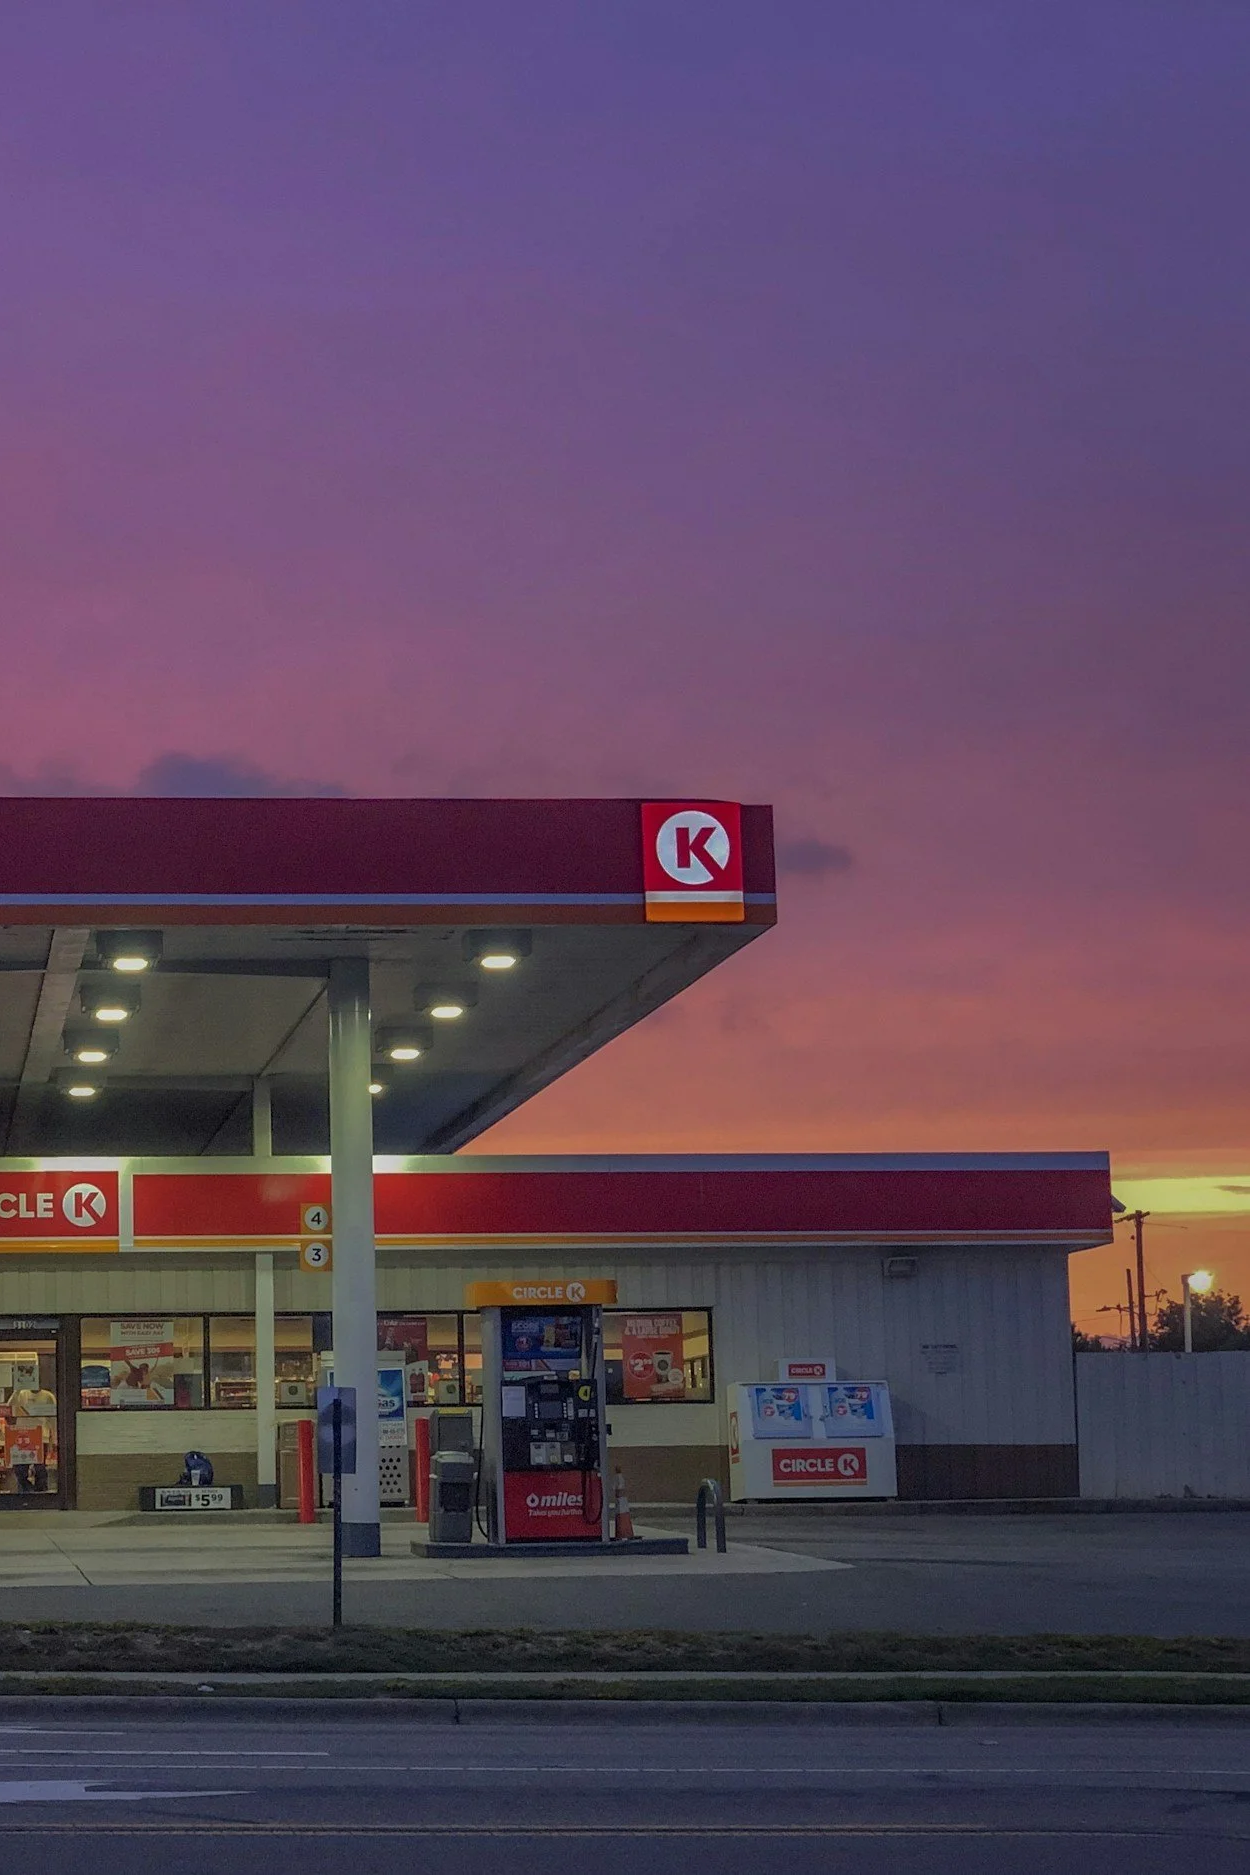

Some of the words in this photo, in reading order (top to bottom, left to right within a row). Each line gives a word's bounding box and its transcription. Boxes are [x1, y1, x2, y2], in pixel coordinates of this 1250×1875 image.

[676, 827, 724, 880] K
[311, 1212, 322, 1225] 4
[312, 1248, 322, 1261] 3
[512, 1287, 564, 1299] CIRCLE
[779, 1458, 835, 1473] CIRCLE
